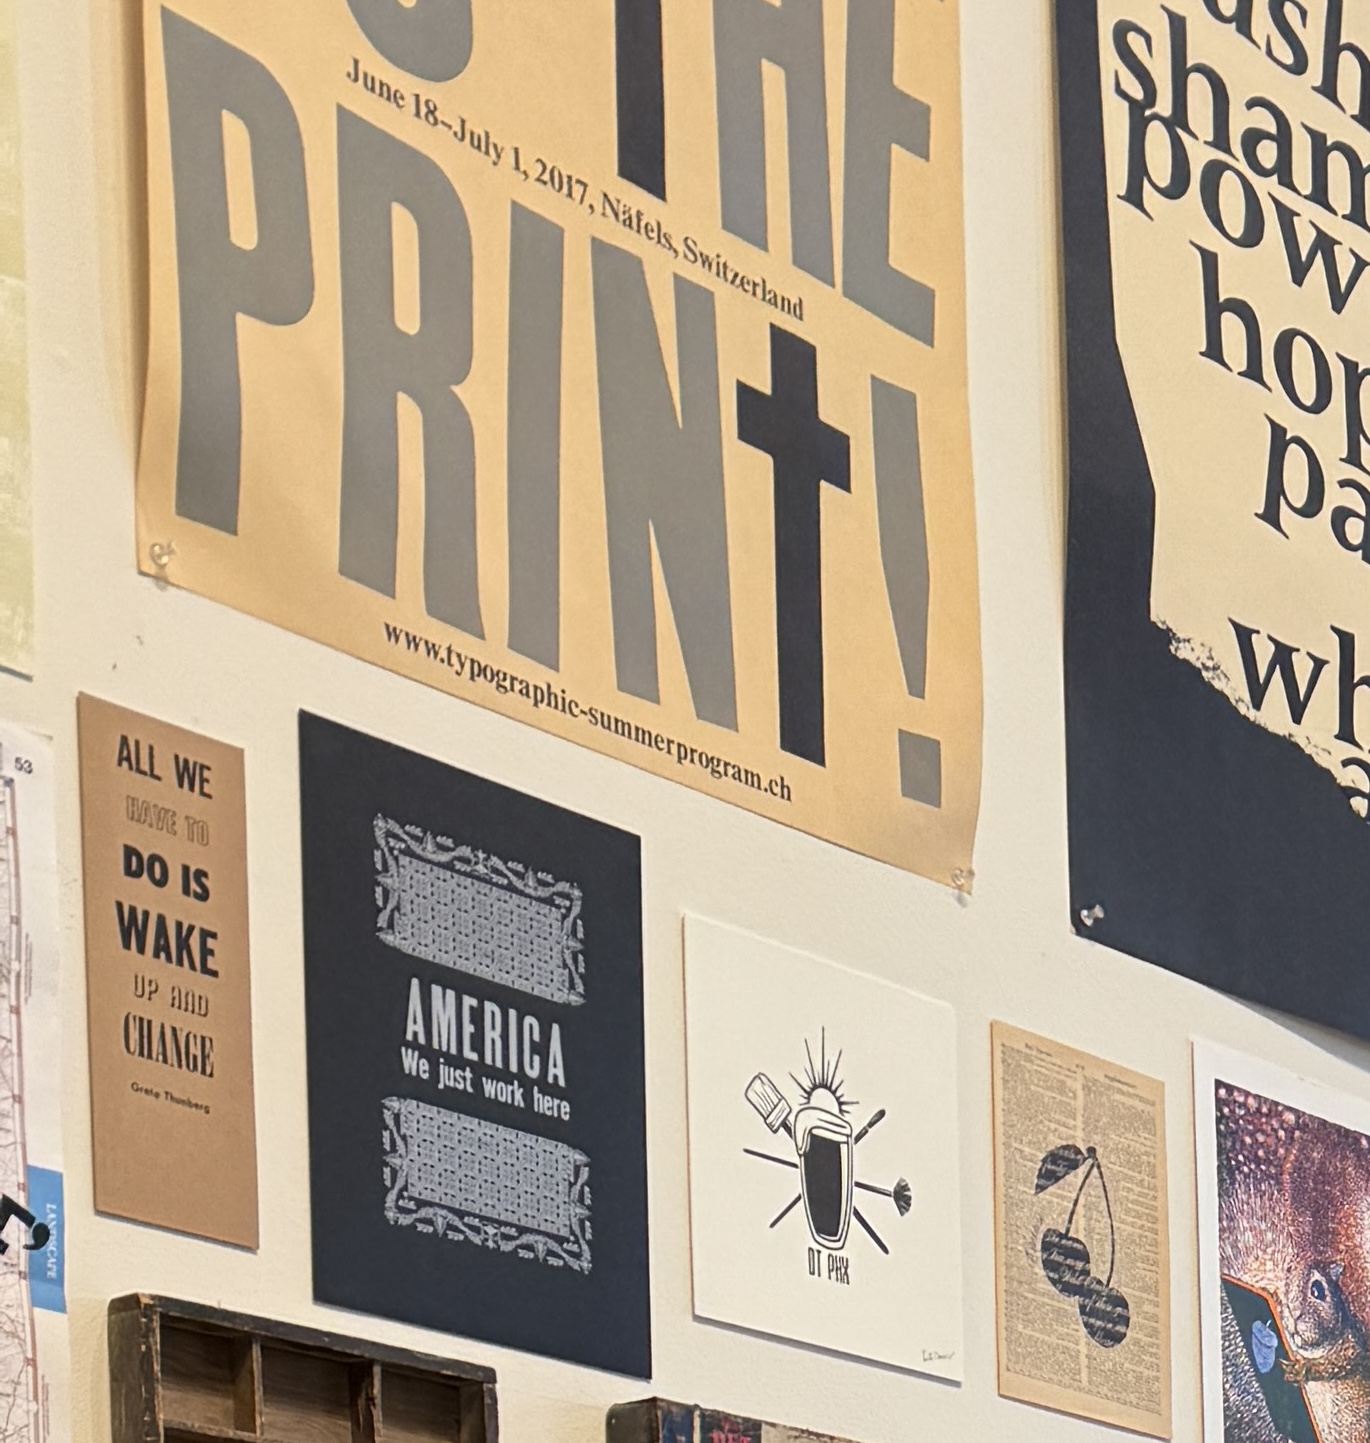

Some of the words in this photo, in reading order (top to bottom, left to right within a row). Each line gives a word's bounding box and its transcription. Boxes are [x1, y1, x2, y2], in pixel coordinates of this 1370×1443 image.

[346, 56, 405, 109] June
[535, 159, 596, 215] 2017,
[682, 237, 805, 320] Switzerland
[383, 621, 791, 801] www.typographic-summerprogram.ch
[15, 758, 32, 774] 53
[116, 901, 219, 977] WAKE
[124, 1012, 214, 1079] CHANGE
[406, 976, 566, 1088] AMERICA
[401, 1048, 431, 1079] We
[438, 1059, 473, 1092] just
[482, 1076, 524, 1108] work
[534, 1091, 569, 1120] here
